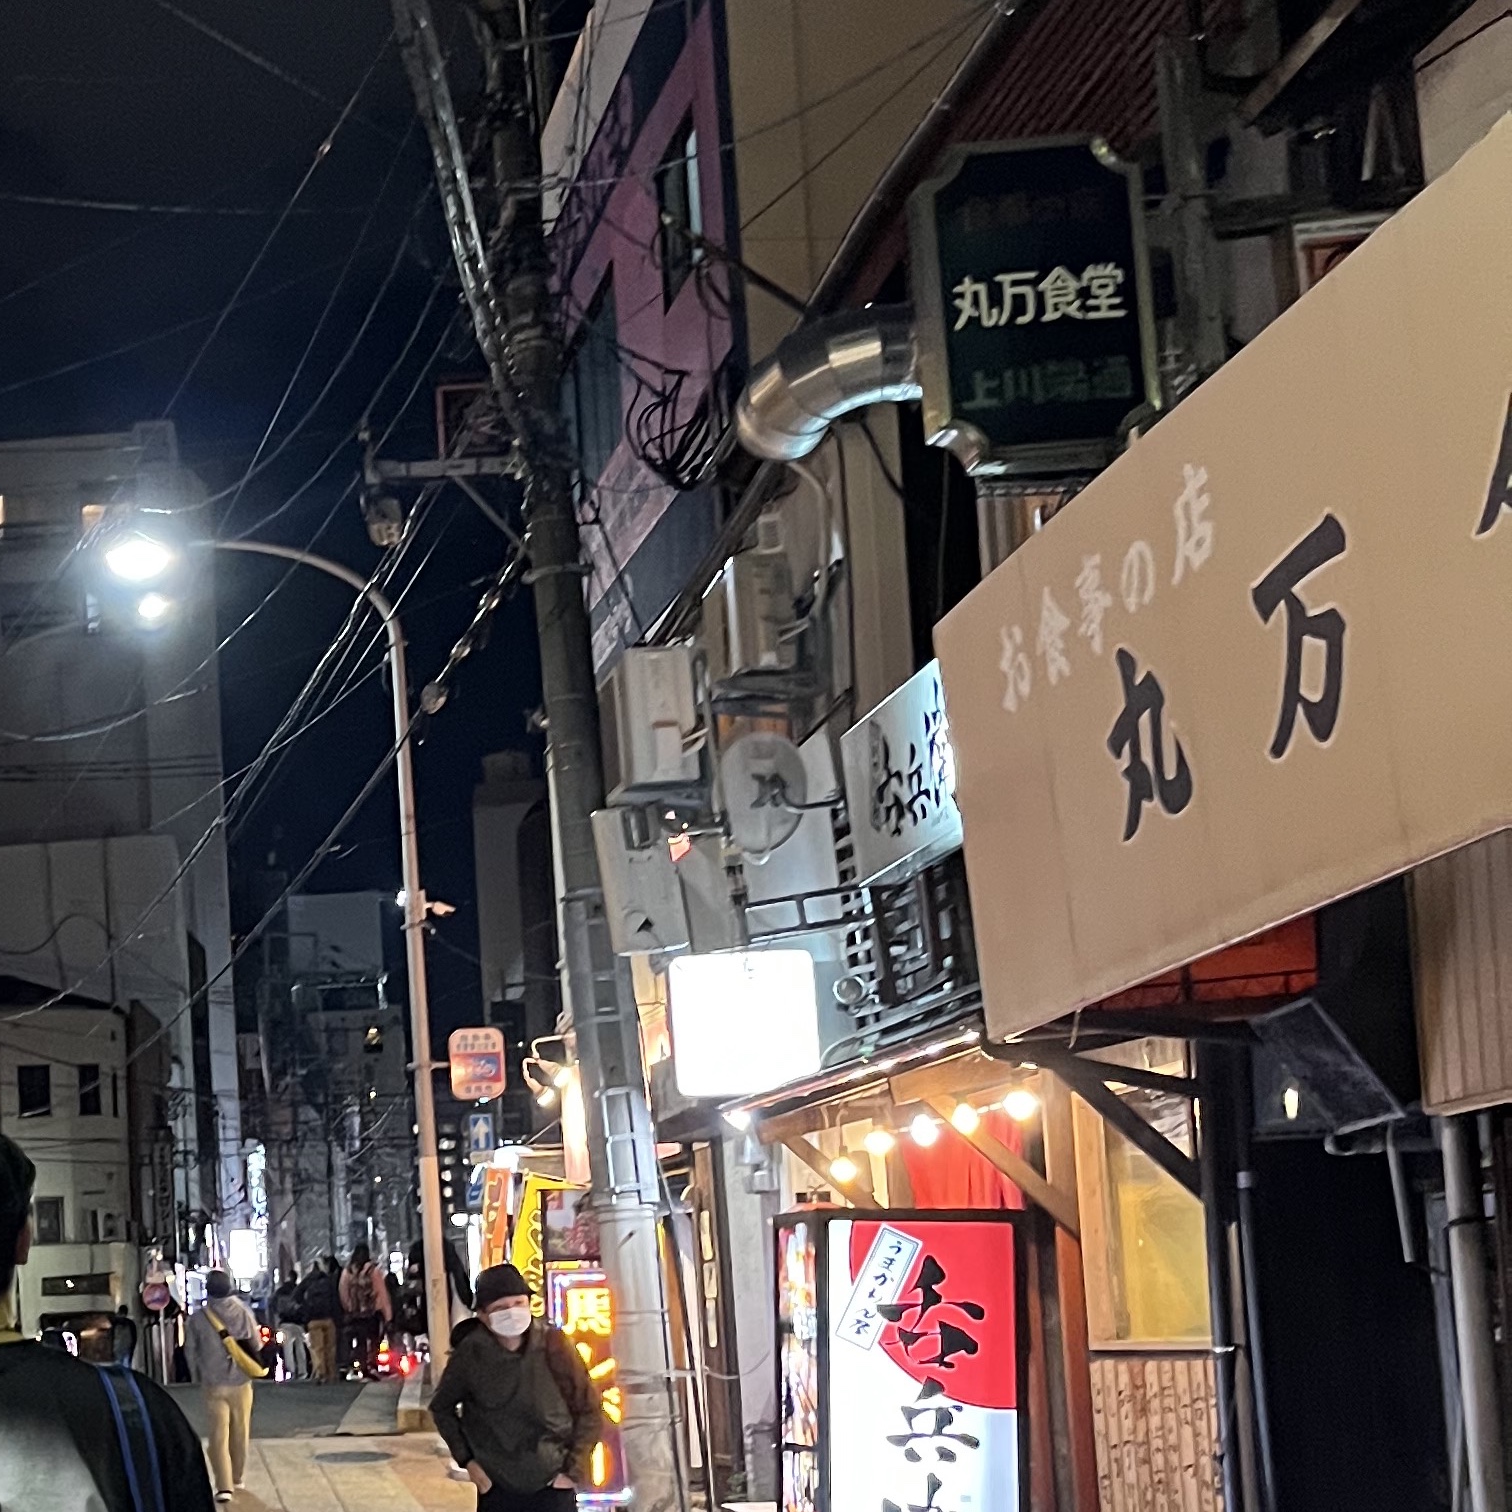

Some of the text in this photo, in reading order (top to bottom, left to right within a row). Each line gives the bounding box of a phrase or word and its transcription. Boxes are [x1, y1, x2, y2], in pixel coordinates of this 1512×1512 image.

[952, 261, 1128, 332] 丸万食堂
[1000, 463, 1215, 713] お食事の店
